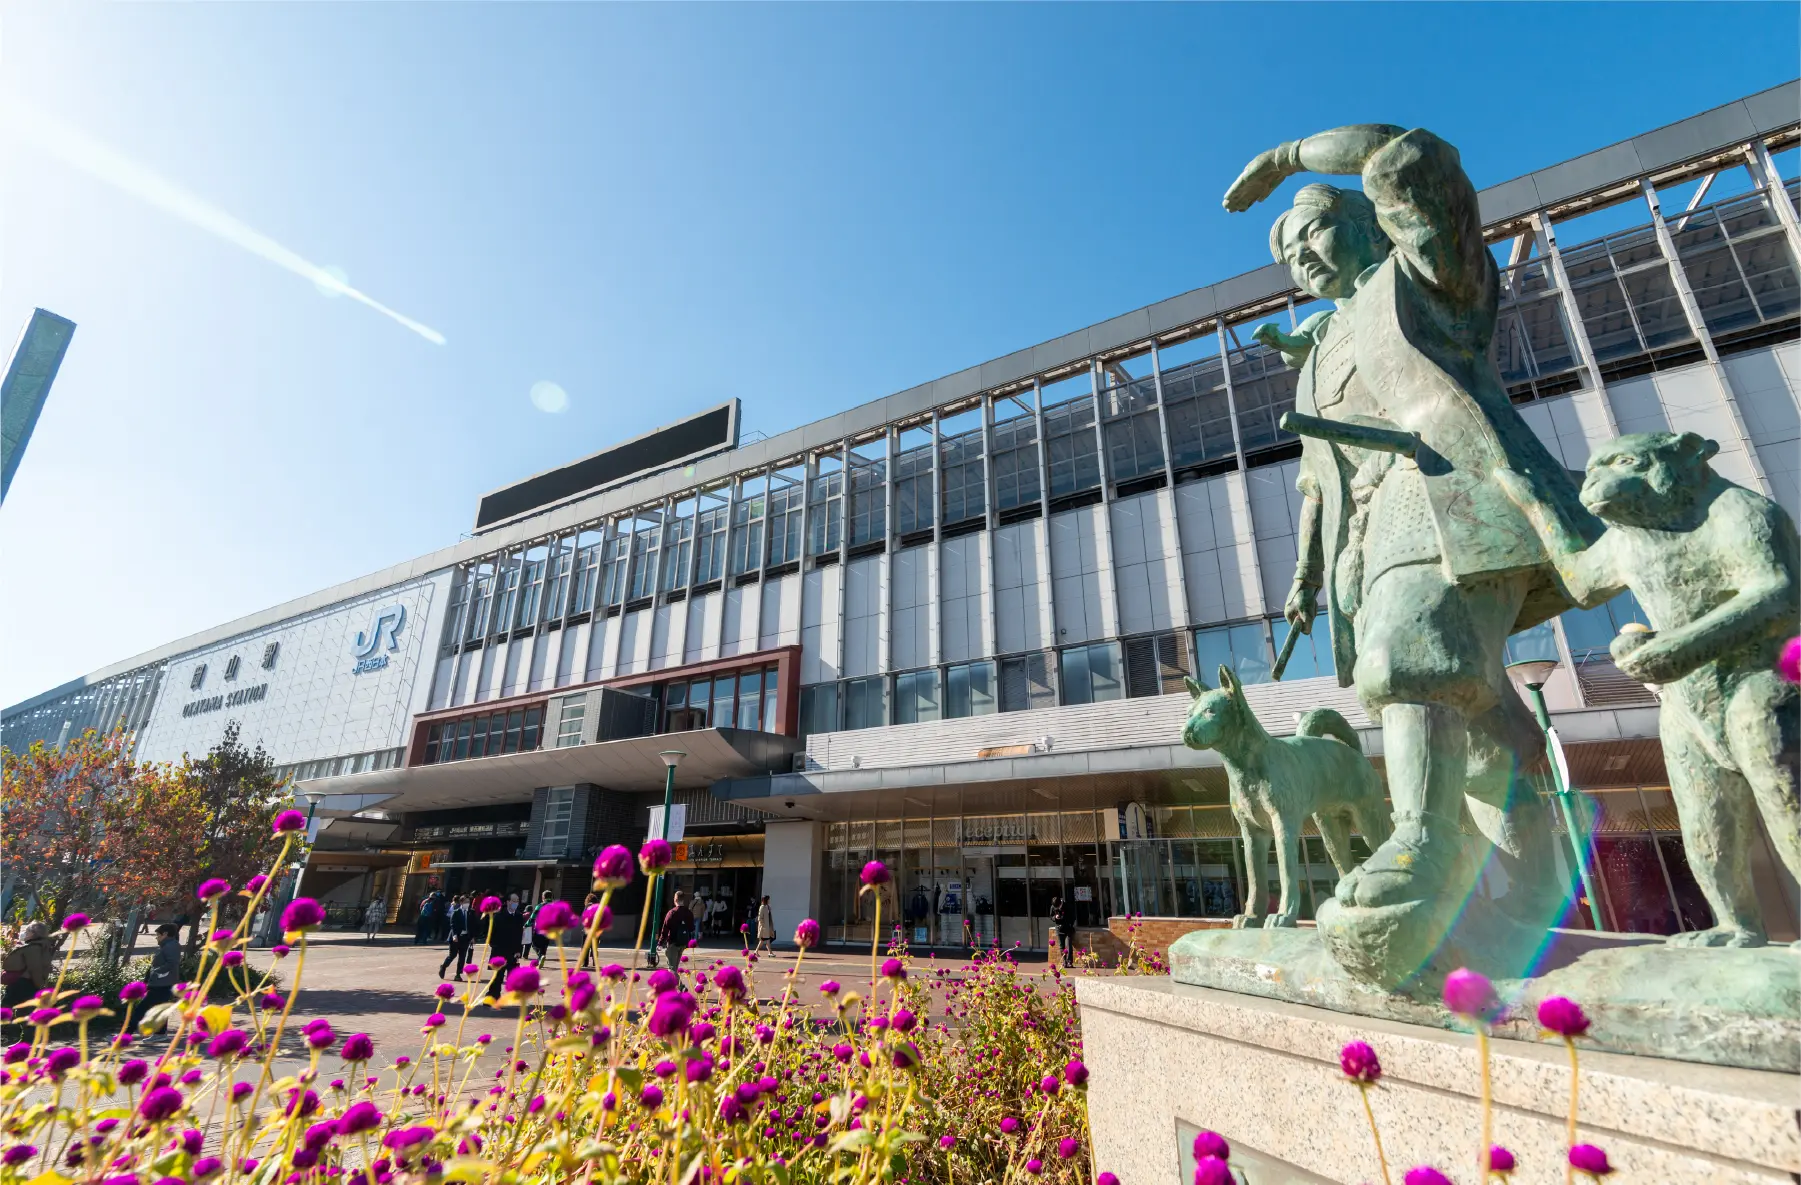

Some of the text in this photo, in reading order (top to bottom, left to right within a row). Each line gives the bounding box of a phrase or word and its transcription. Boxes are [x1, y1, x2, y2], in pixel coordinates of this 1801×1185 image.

[351, 604, 405, 659] JR
[190, 641, 279, 691] 岡山駅
[182, 683, 268, 718] OKAYAMA STATION
